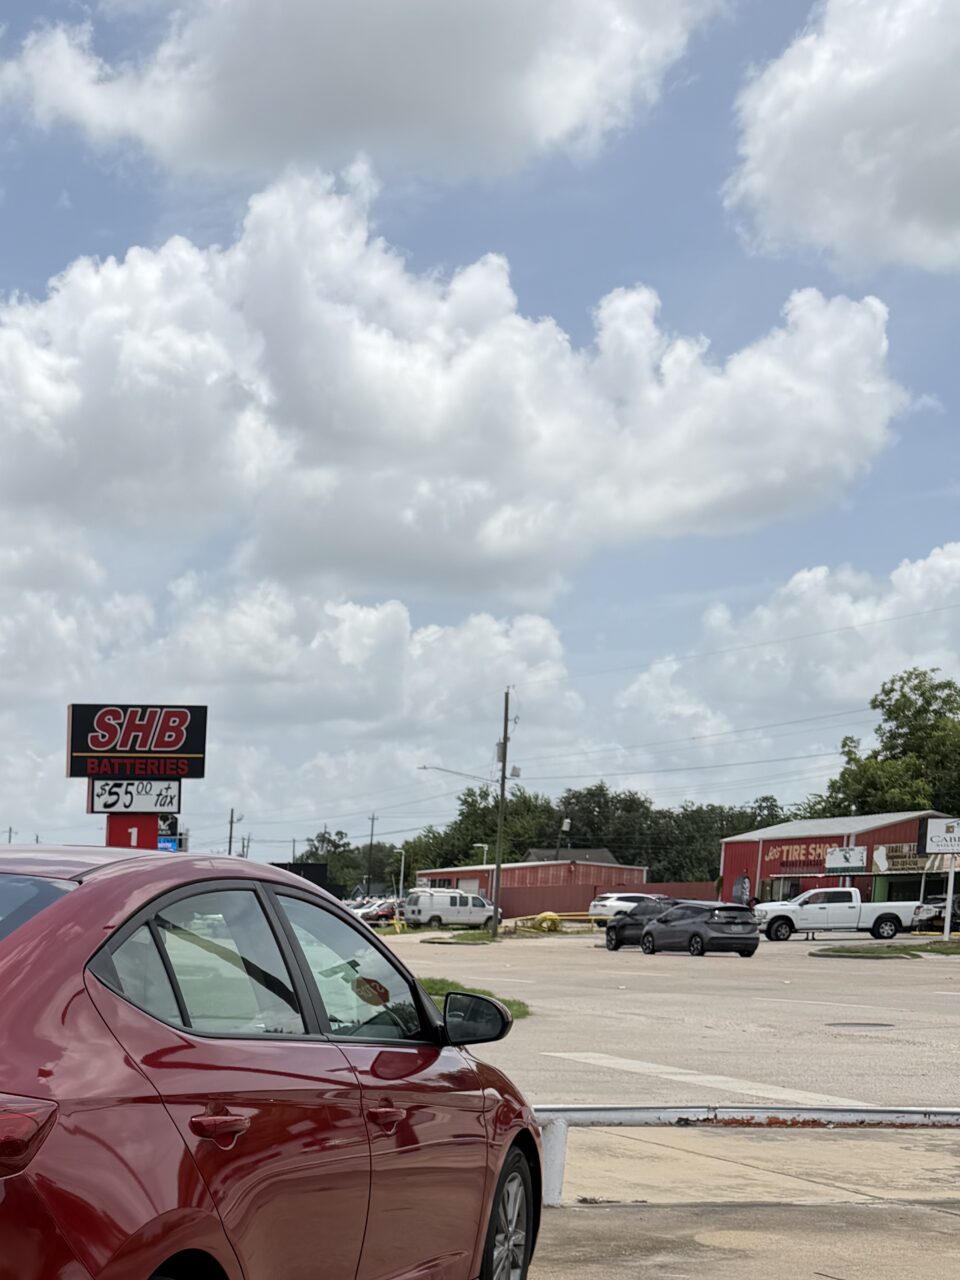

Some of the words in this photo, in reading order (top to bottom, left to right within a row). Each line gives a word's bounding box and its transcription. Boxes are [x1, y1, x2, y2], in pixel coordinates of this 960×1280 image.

[88, 706, 191, 751] SHB
[87, 758, 189, 776] BATTERIES
[154, 788, 176, 807] tax
[782, 845, 806, 861] TIRE
[808, 843, 838, 861] SHO
